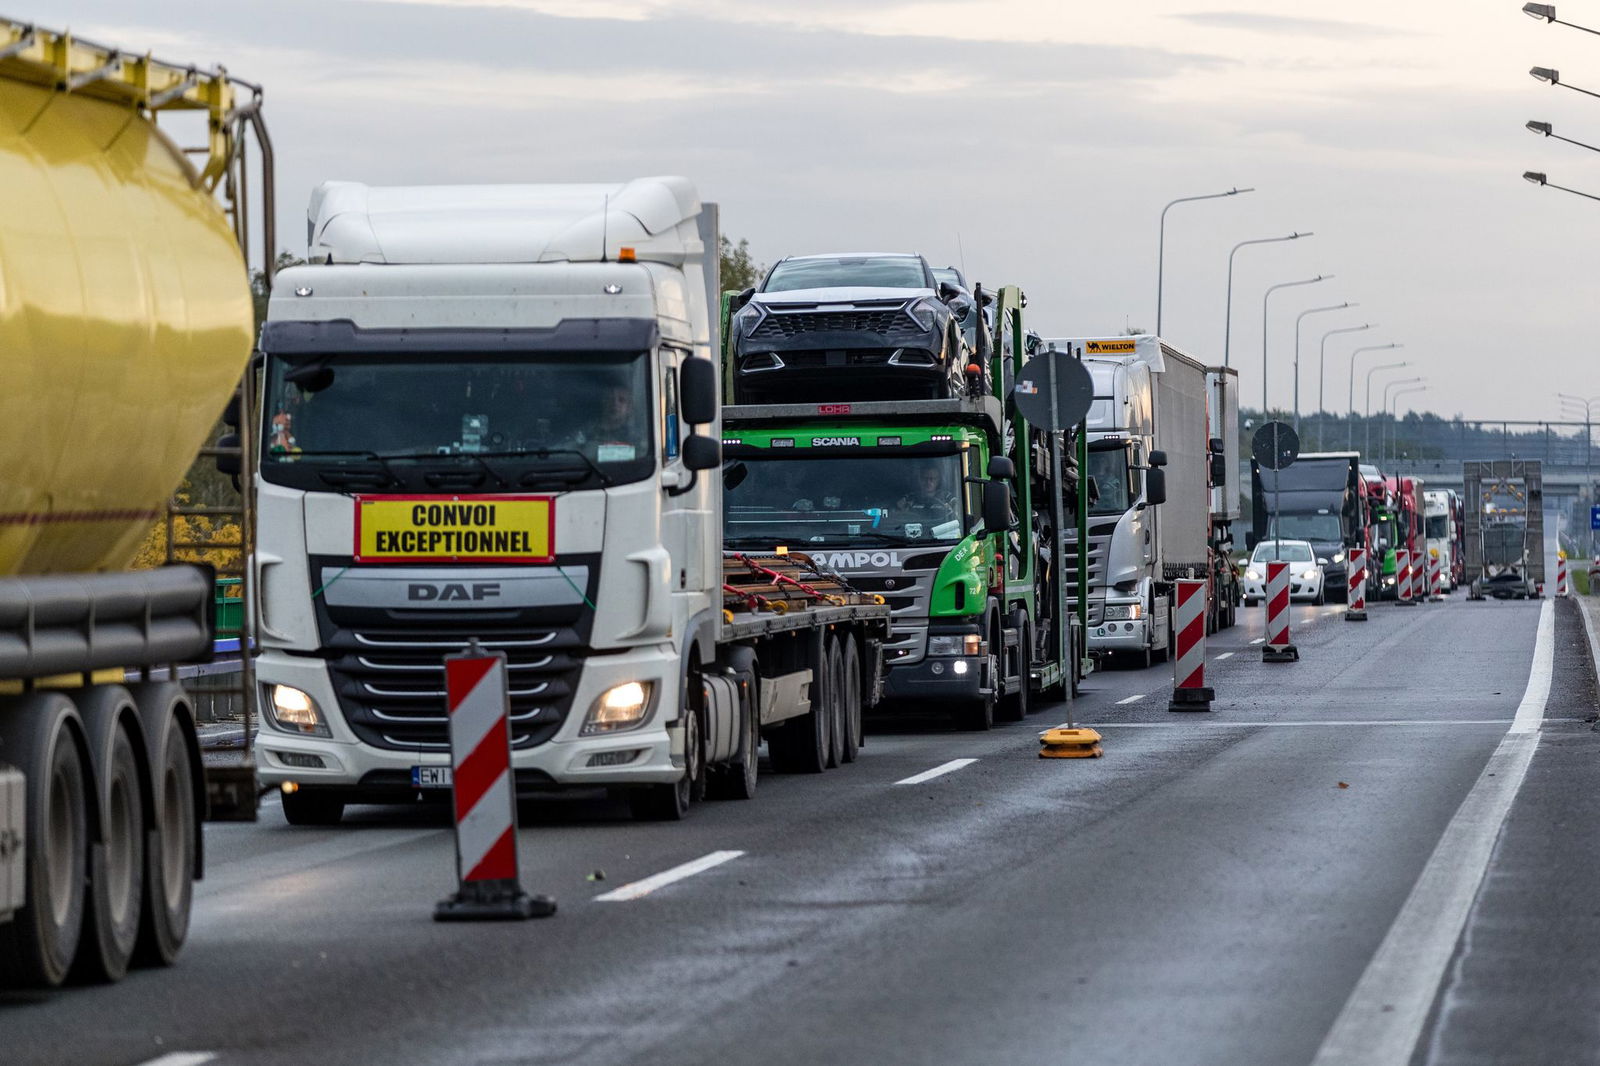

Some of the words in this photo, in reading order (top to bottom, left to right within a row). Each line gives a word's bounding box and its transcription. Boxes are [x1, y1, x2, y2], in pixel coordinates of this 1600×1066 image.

[812, 437, 860, 447] SCANIA
[412, 504, 496, 527] CONVOI
[376, 531, 532, 553] EXCEPTIONNEL
[408, 583, 500, 600] DAF
[420, 768, 446, 784] EWI
